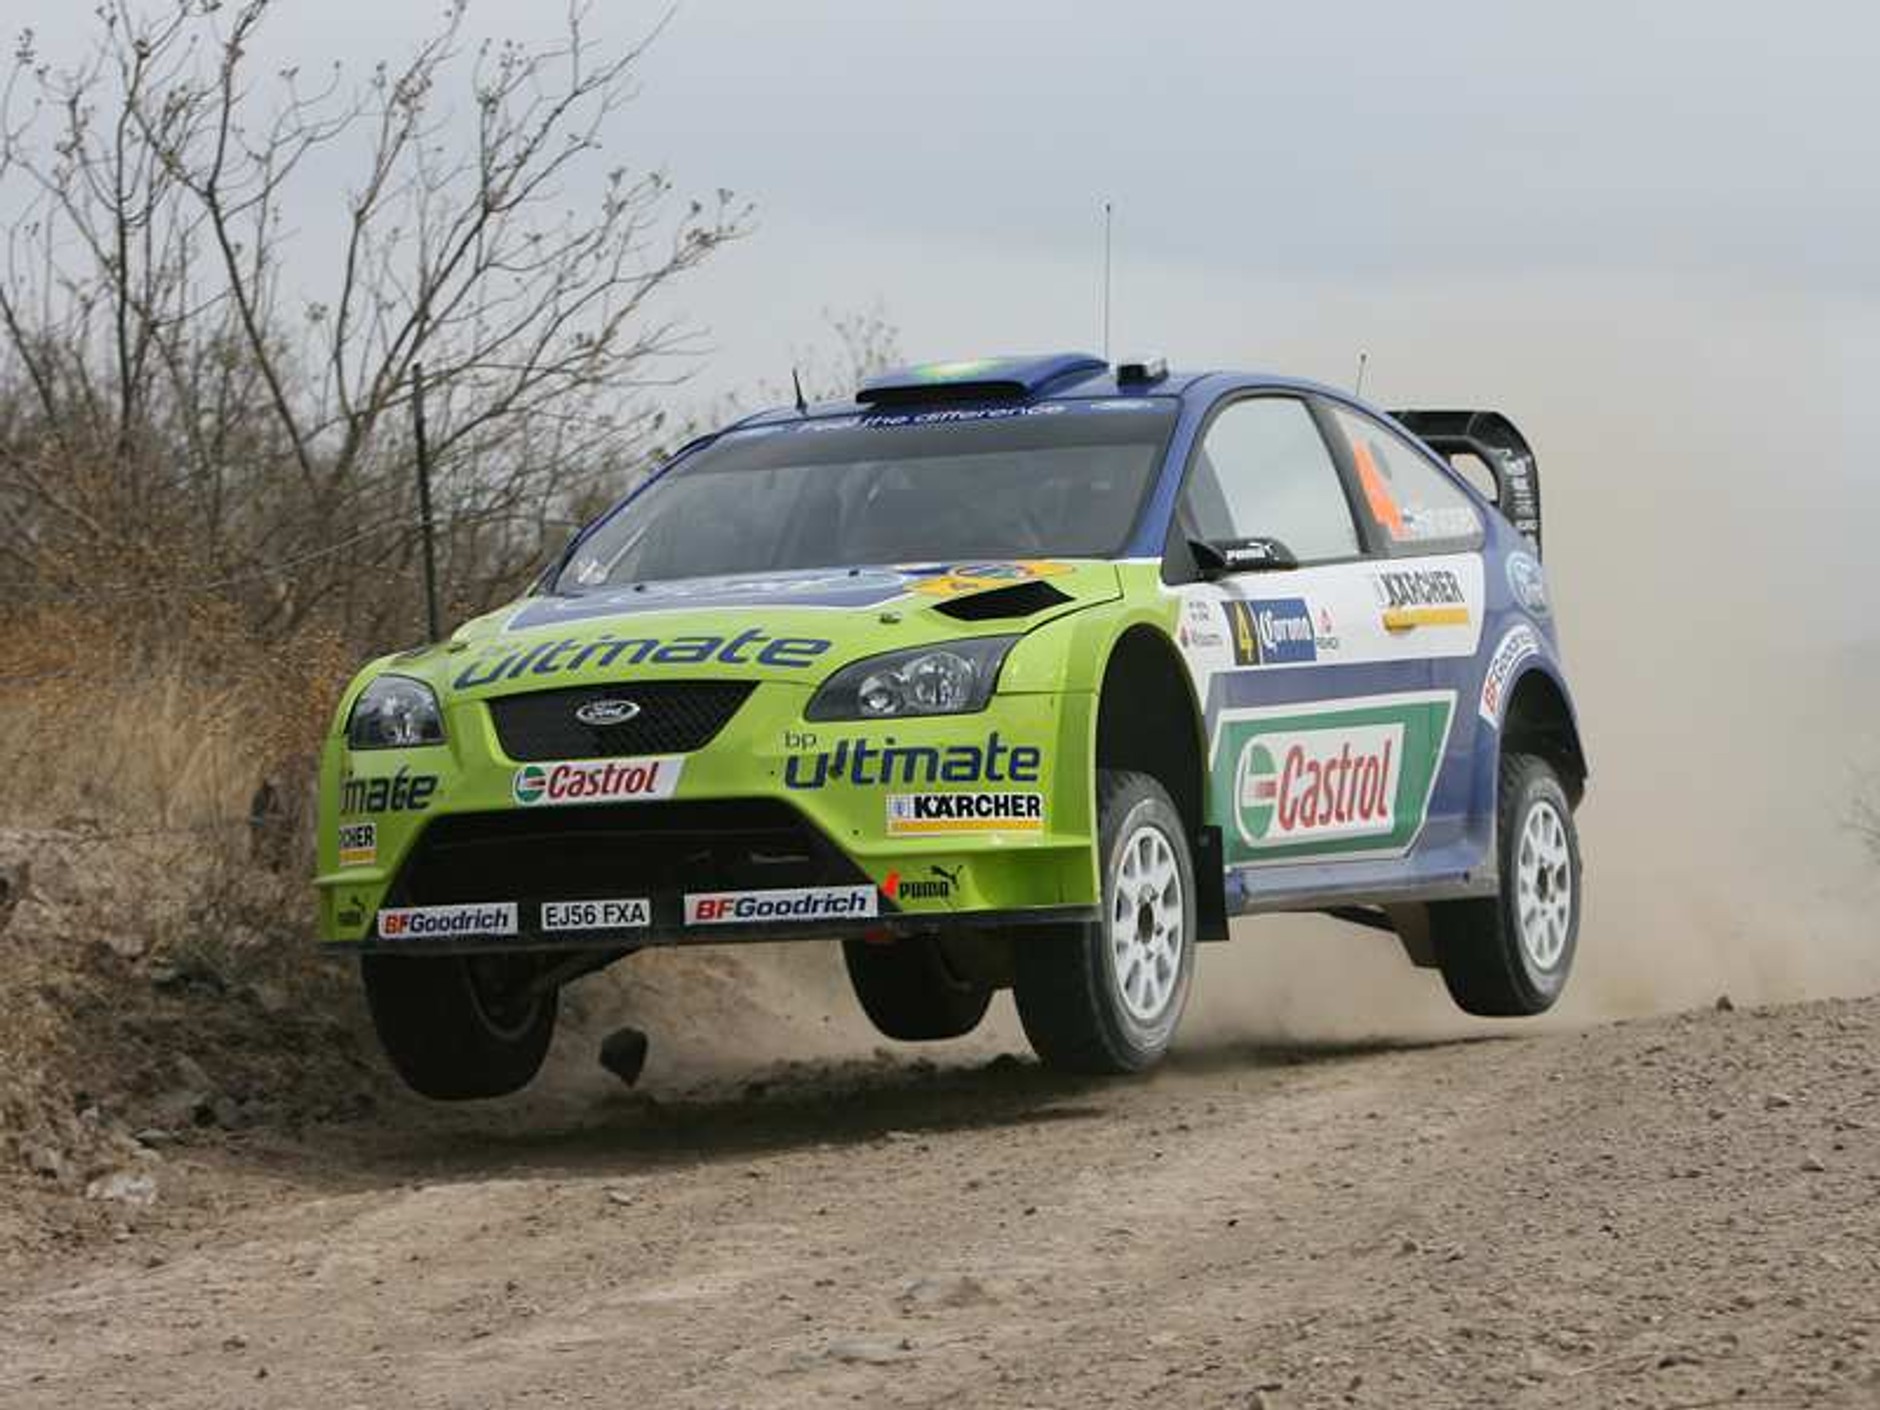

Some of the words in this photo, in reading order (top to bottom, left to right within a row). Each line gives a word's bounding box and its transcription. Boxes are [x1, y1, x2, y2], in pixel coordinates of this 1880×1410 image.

[1235, 602, 1254, 662] 4
[453, 628, 832, 690] ultimate
[785, 731, 816, 749] bp
[785, 732, 1041, 789] ultimate
[548, 761, 659, 798] Castrol
[1277, 739, 1393, 831] Castrol
[914, 793, 1041, 819] KÄRCHER
[384, 909, 509, 934] BFGoodrich
[545, 905, 596, 927] EJ56
[603, 902, 646, 924] FXA
[695, 893, 866, 920] BFGoodrich
